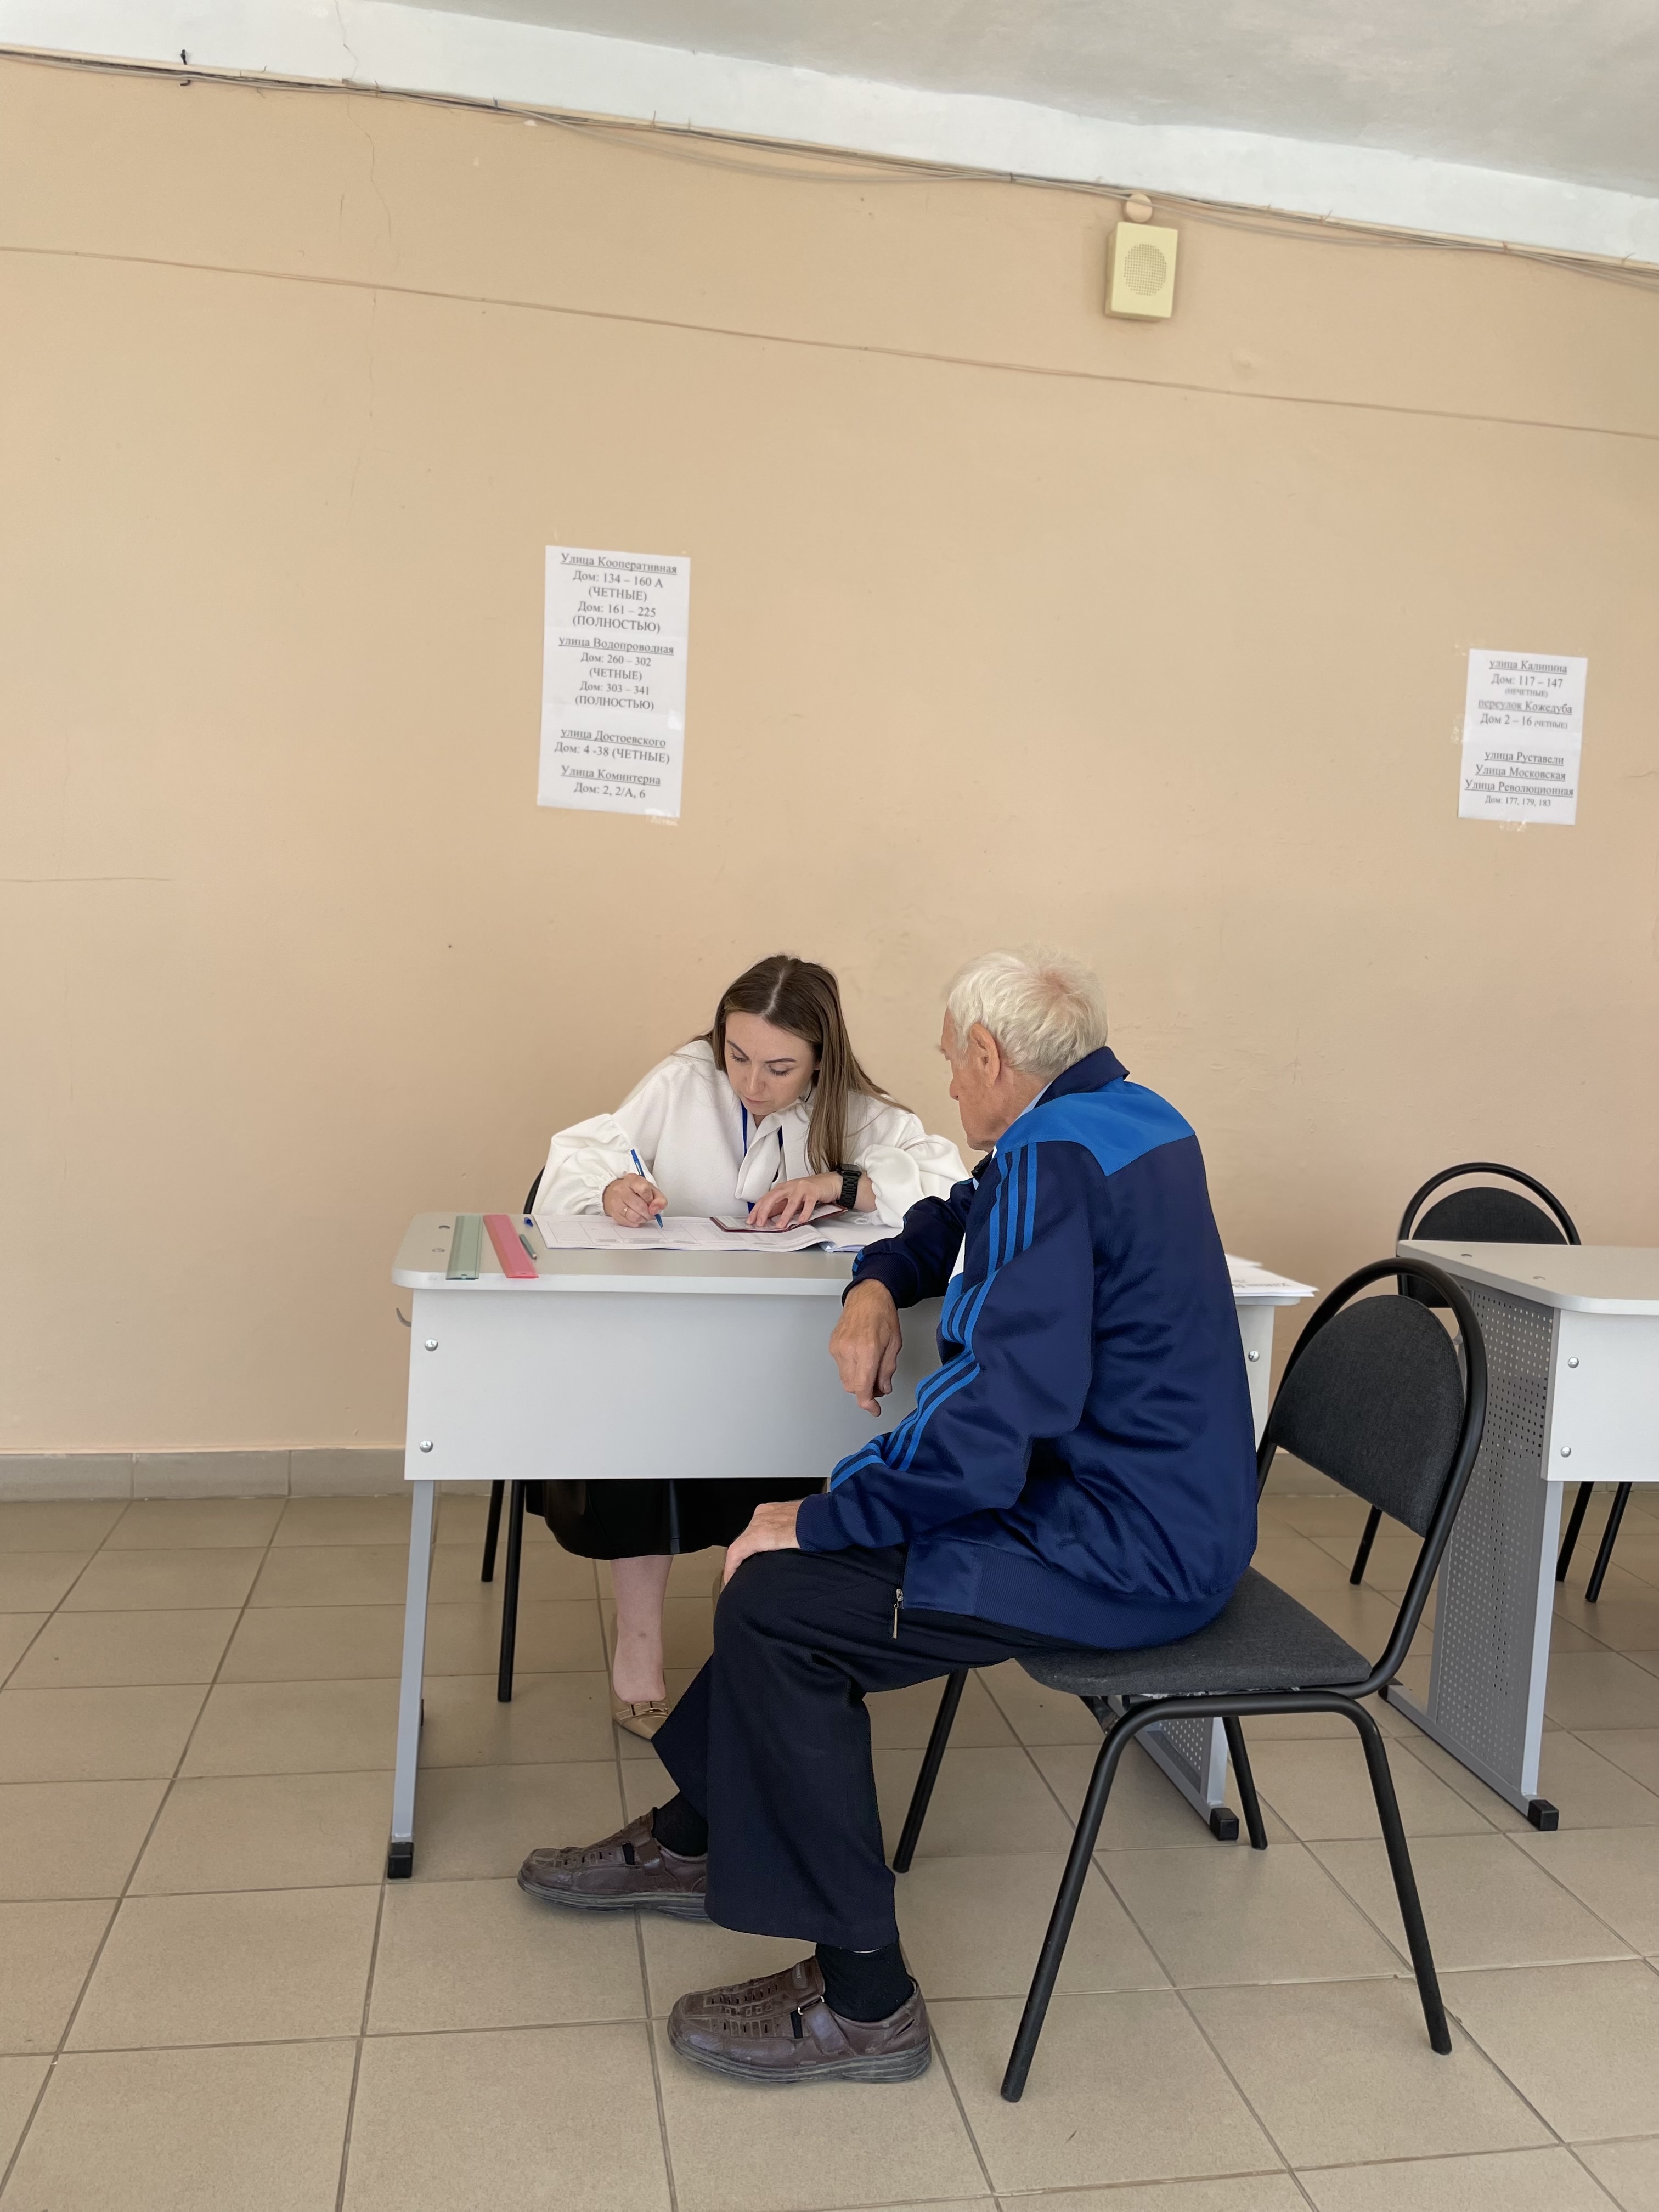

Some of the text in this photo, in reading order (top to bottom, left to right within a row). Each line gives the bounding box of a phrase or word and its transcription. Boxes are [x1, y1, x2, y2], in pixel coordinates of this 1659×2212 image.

[561, 552, 677, 573] Улица Кооперативная
[573, 570, 599, 581] Дом:
[603, 573, 620, 583] 134
[635, 576, 651, 586] 160
[589, 586, 647, 602] (ЧЕТНЫЕ)
[578, 601, 604, 612] Дом:
[608, 604, 624, 614] 161
[638, 607, 656, 617] 225
[572, 615, 660, 634] (ПОЛНОСТЬЮ)
[558, 637, 674, 654] улица Водопроводная
[580, 652, 604, 663] Дом:
[607, 654, 624, 664] 260
[635, 657, 651, 666] 302
[1489, 660, 1567, 673] улица Калинина
[589, 668, 642, 681] (ЧЕТНЫЕ)
[1491, 674, 1515, 685] Дом:
[1519, 676, 1535, 686] 117
[1547, 678, 1563, 688] 147
[579, 681, 603, 691] Дом:
[606, 684, 622, 692] 303
[634, 686, 650, 695] 341
[1505, 688, 1548, 698] (НЕЧЕТНЫЕ)
[575, 695, 654, 711] (ПОЛНОСТЬЮ)
[1478, 699, 1572, 715] переулок Кожедуба
[1480, 713, 1501, 724] Дом
[1504, 715, 1510, 724] 2
[1522, 716, 1532, 726] 16
[1534, 720, 1567, 729] (ЧЕТНЫЕ)
[561, 729, 665, 747] улица Достоевского
[554, 742, 580, 753] Дом:
[583, 745, 590, 754] 4
[612, 748, 670, 764] (ЧЕТНЫЕ)
[1485, 751, 1564, 764] улица Руставели
[561, 765, 661, 785] Улица Коминтерна
[1475, 764, 1566, 780] Улица Московская
[574, 783, 600, 793] Дом:
[603, 786, 612, 796] 2,
[639, 789, 645, 798] 6
[1465, 779, 1573, 795] Улица Революционная
[1485, 795, 1503, 804] Дом:
[1506, 797, 1519, 805] 177,
[1522, 798, 1536, 806] 179,
